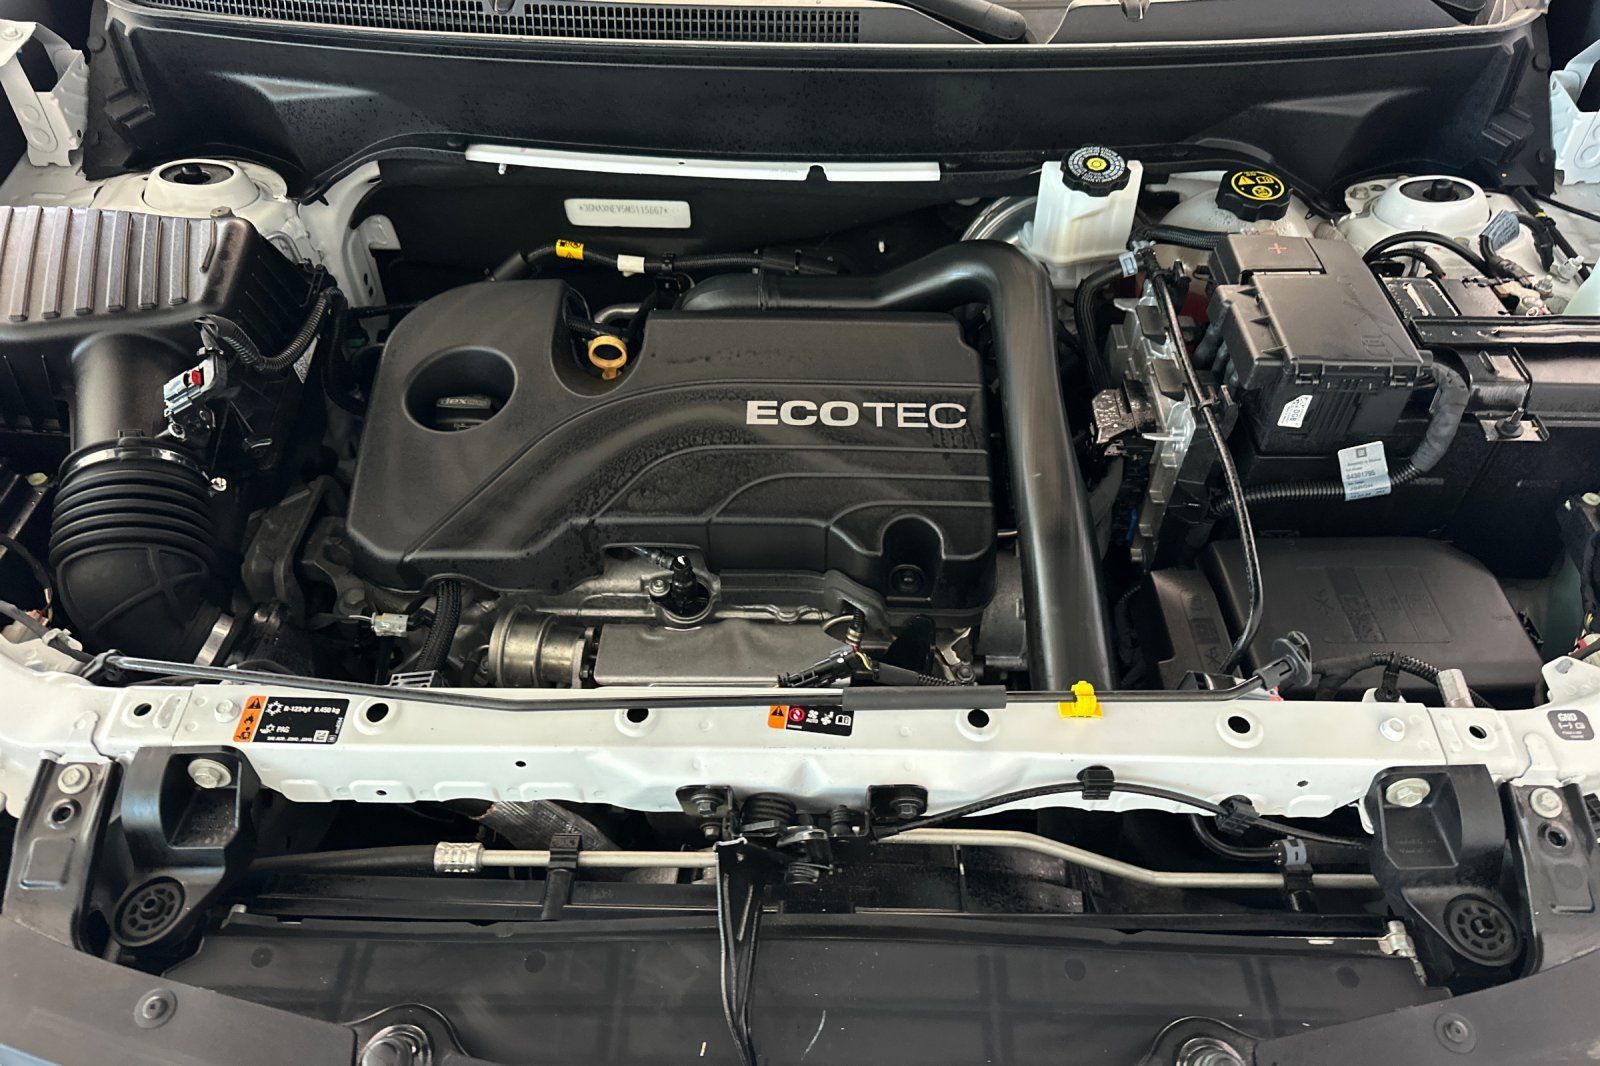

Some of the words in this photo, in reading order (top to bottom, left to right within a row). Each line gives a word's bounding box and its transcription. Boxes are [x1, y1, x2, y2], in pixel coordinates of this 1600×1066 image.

[746, 400, 967, 428] ECOTEC
[283, 705, 312, 714] R-1234yf
[314, 706, 331, 714] 0.450
[331, 706, 341, 715] kg
[1557, 712, 1578, 722] GND
[276, 725, 290, 733] PAG
